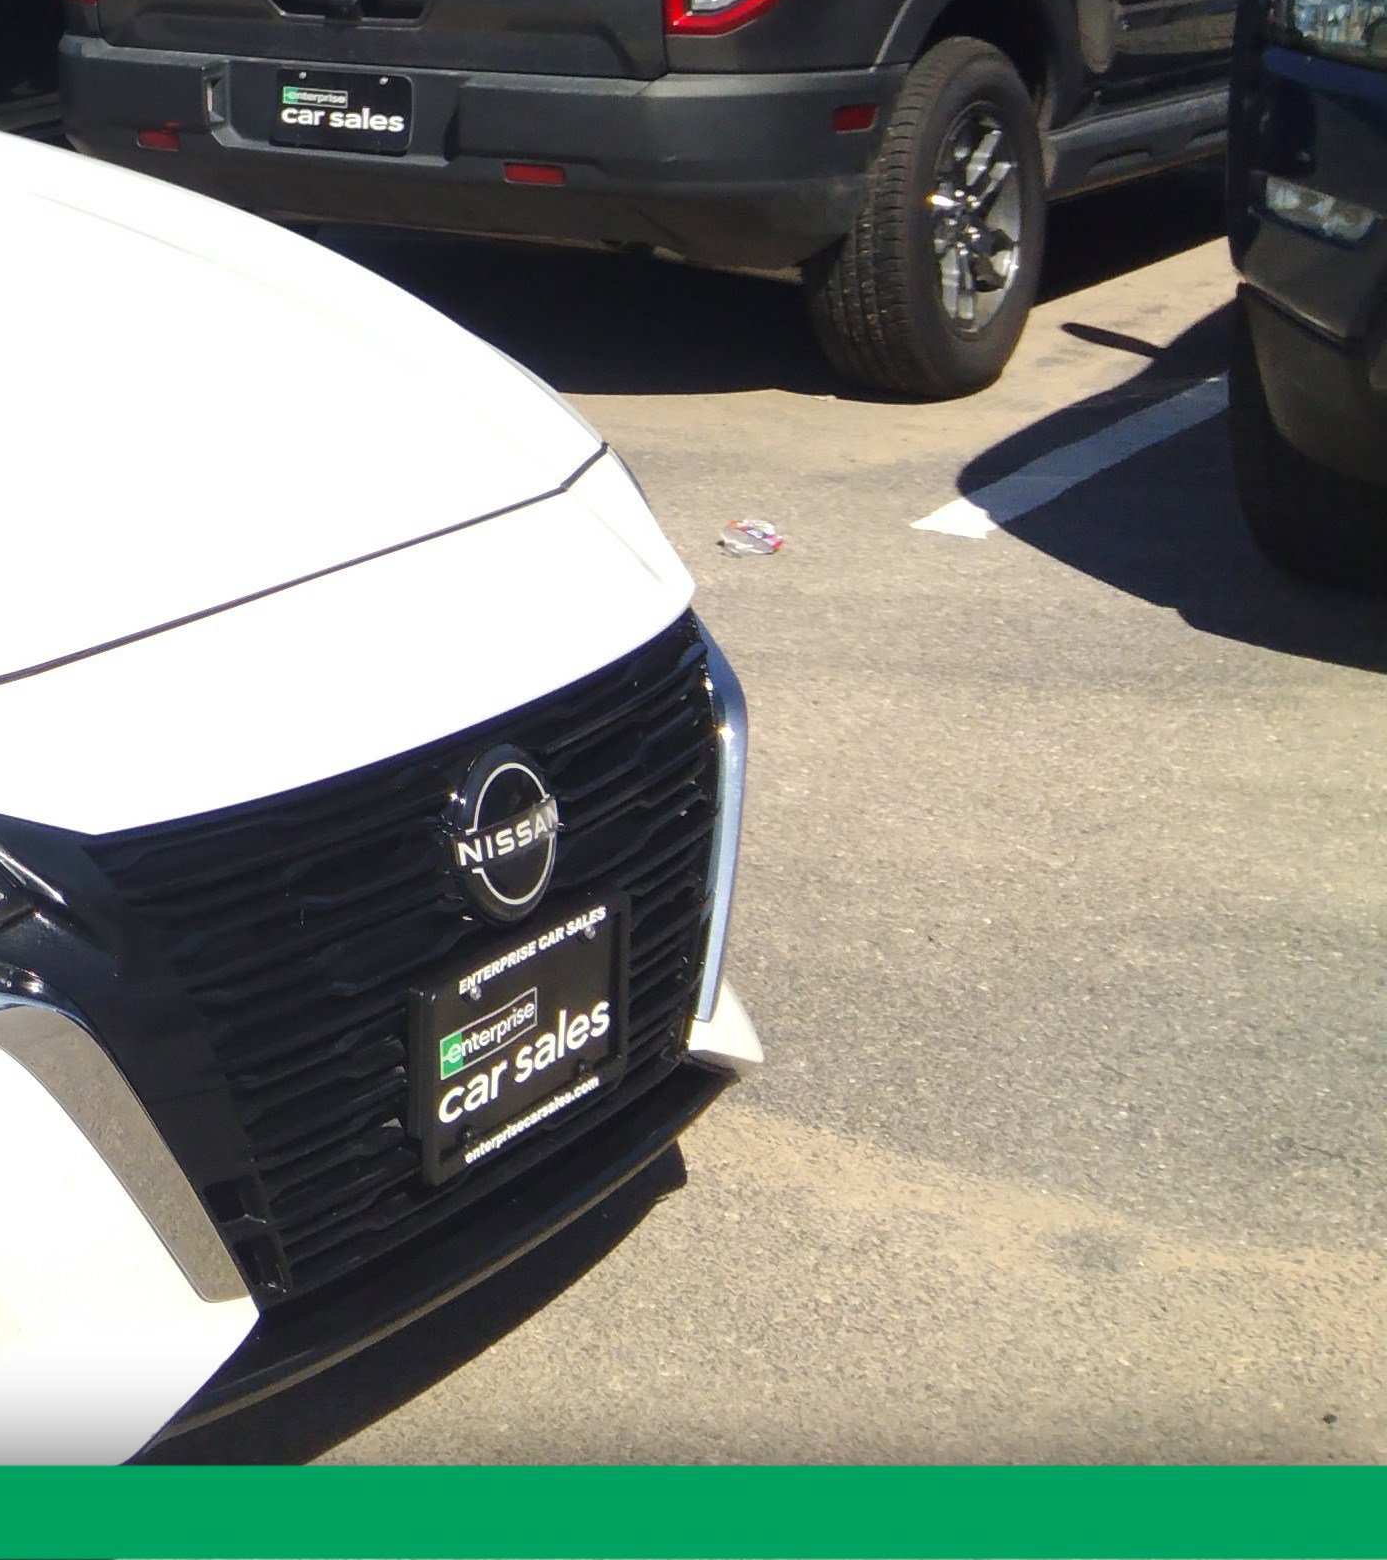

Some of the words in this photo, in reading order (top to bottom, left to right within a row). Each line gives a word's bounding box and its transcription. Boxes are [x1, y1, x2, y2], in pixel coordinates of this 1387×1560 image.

[281, 107, 325, 126] car
[329, 107, 405, 133] sales
[285, 90, 347, 104] enterprise
[457, 797, 560, 868] NISSAN
[458, 941, 537, 995] ENTERPRISE
[537, 927, 565, 953] CAR
[565, 905, 607, 941] SALES
[438, 1060, 513, 1124] car
[514, 1000, 611, 1084] sales
[443, 1000, 535, 1066] enterprise
[463, 1075, 600, 1166] enterprisecarsales.com
